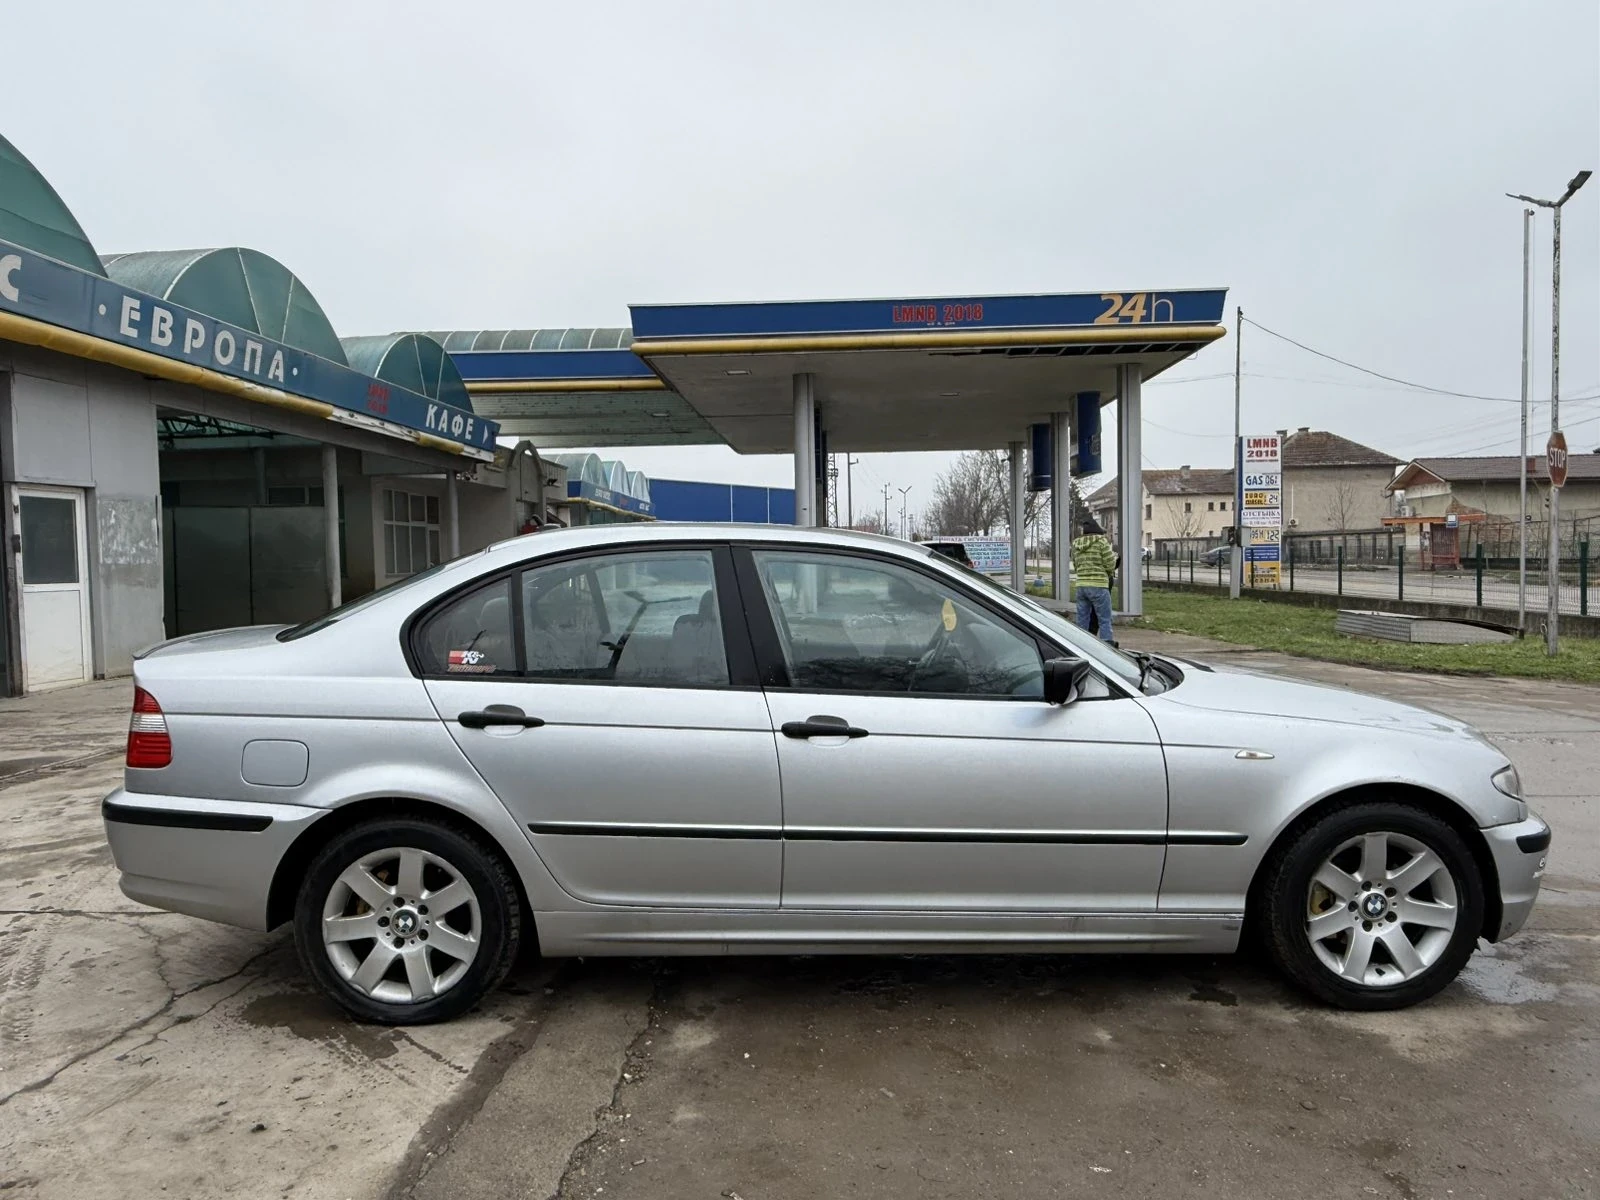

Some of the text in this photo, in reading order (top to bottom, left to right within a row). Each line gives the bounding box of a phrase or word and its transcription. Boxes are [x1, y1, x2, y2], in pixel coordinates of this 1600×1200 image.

[893, 304, 983, 323] LMNB 2018
[119, 295, 285, 383] ЕВРОПА
[425, 404, 474, 441] КАФЕ
[1246, 438, 1278, 448] LMNB
[1246, 450, 1278, 458] 2018
[1549, 447, 1566, 469] STOP
[1245, 475, 1263, 486] GAS
